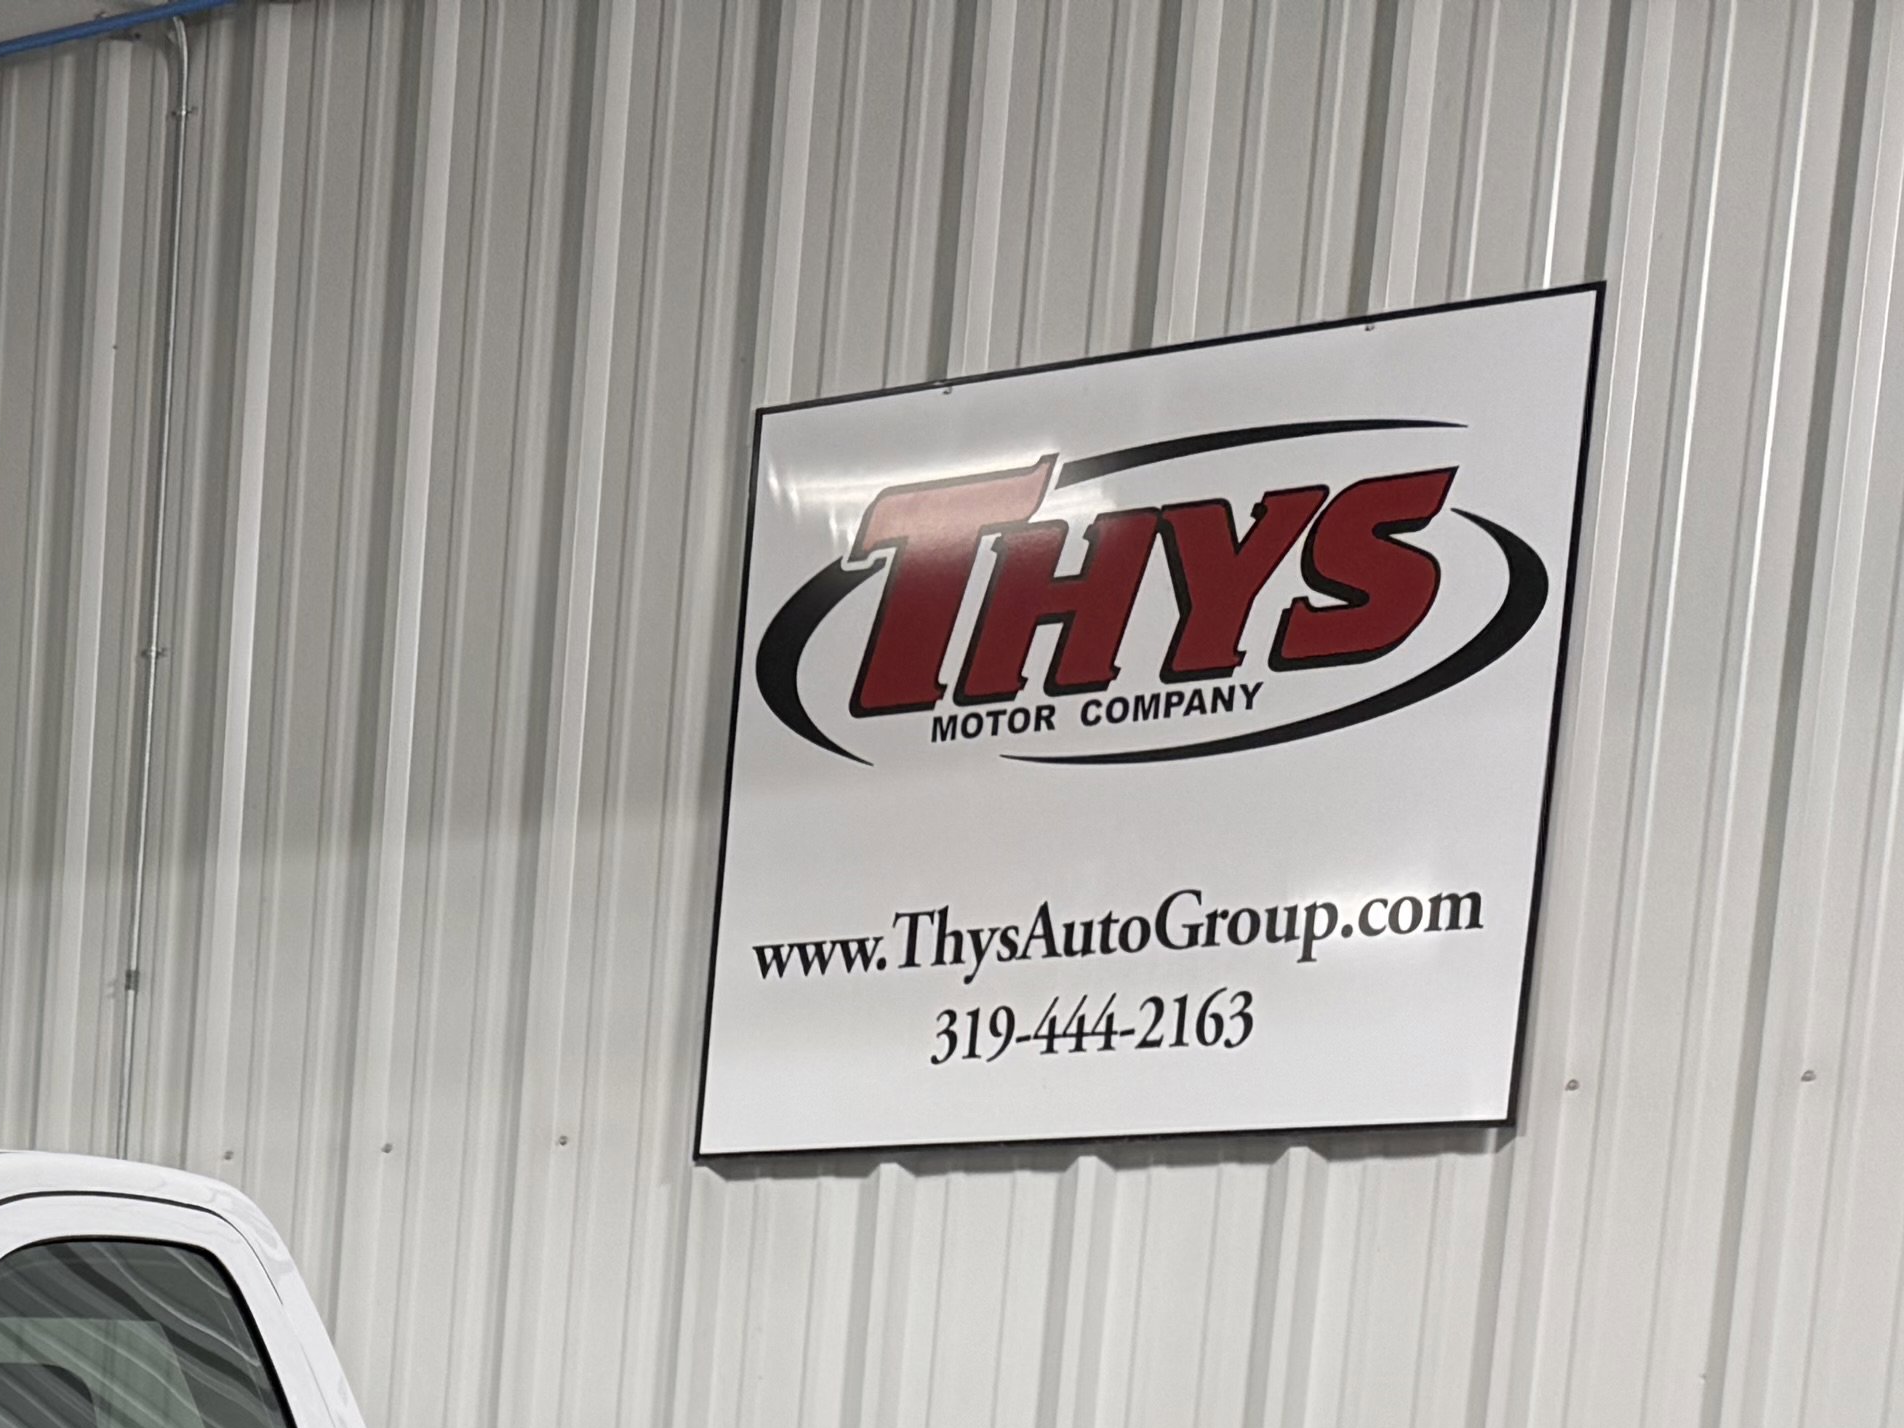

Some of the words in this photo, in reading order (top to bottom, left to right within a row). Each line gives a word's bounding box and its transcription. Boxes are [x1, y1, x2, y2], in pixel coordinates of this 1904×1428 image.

[847, 453, 1459, 719] THYS
[929, 704, 1057, 744] MOTOR
[1079, 681, 1265, 728] COMPANY
[752, 888, 1484, 984] www.ThysAutoGroup.com
[929, 990, 1256, 1066] 319-444-2163
